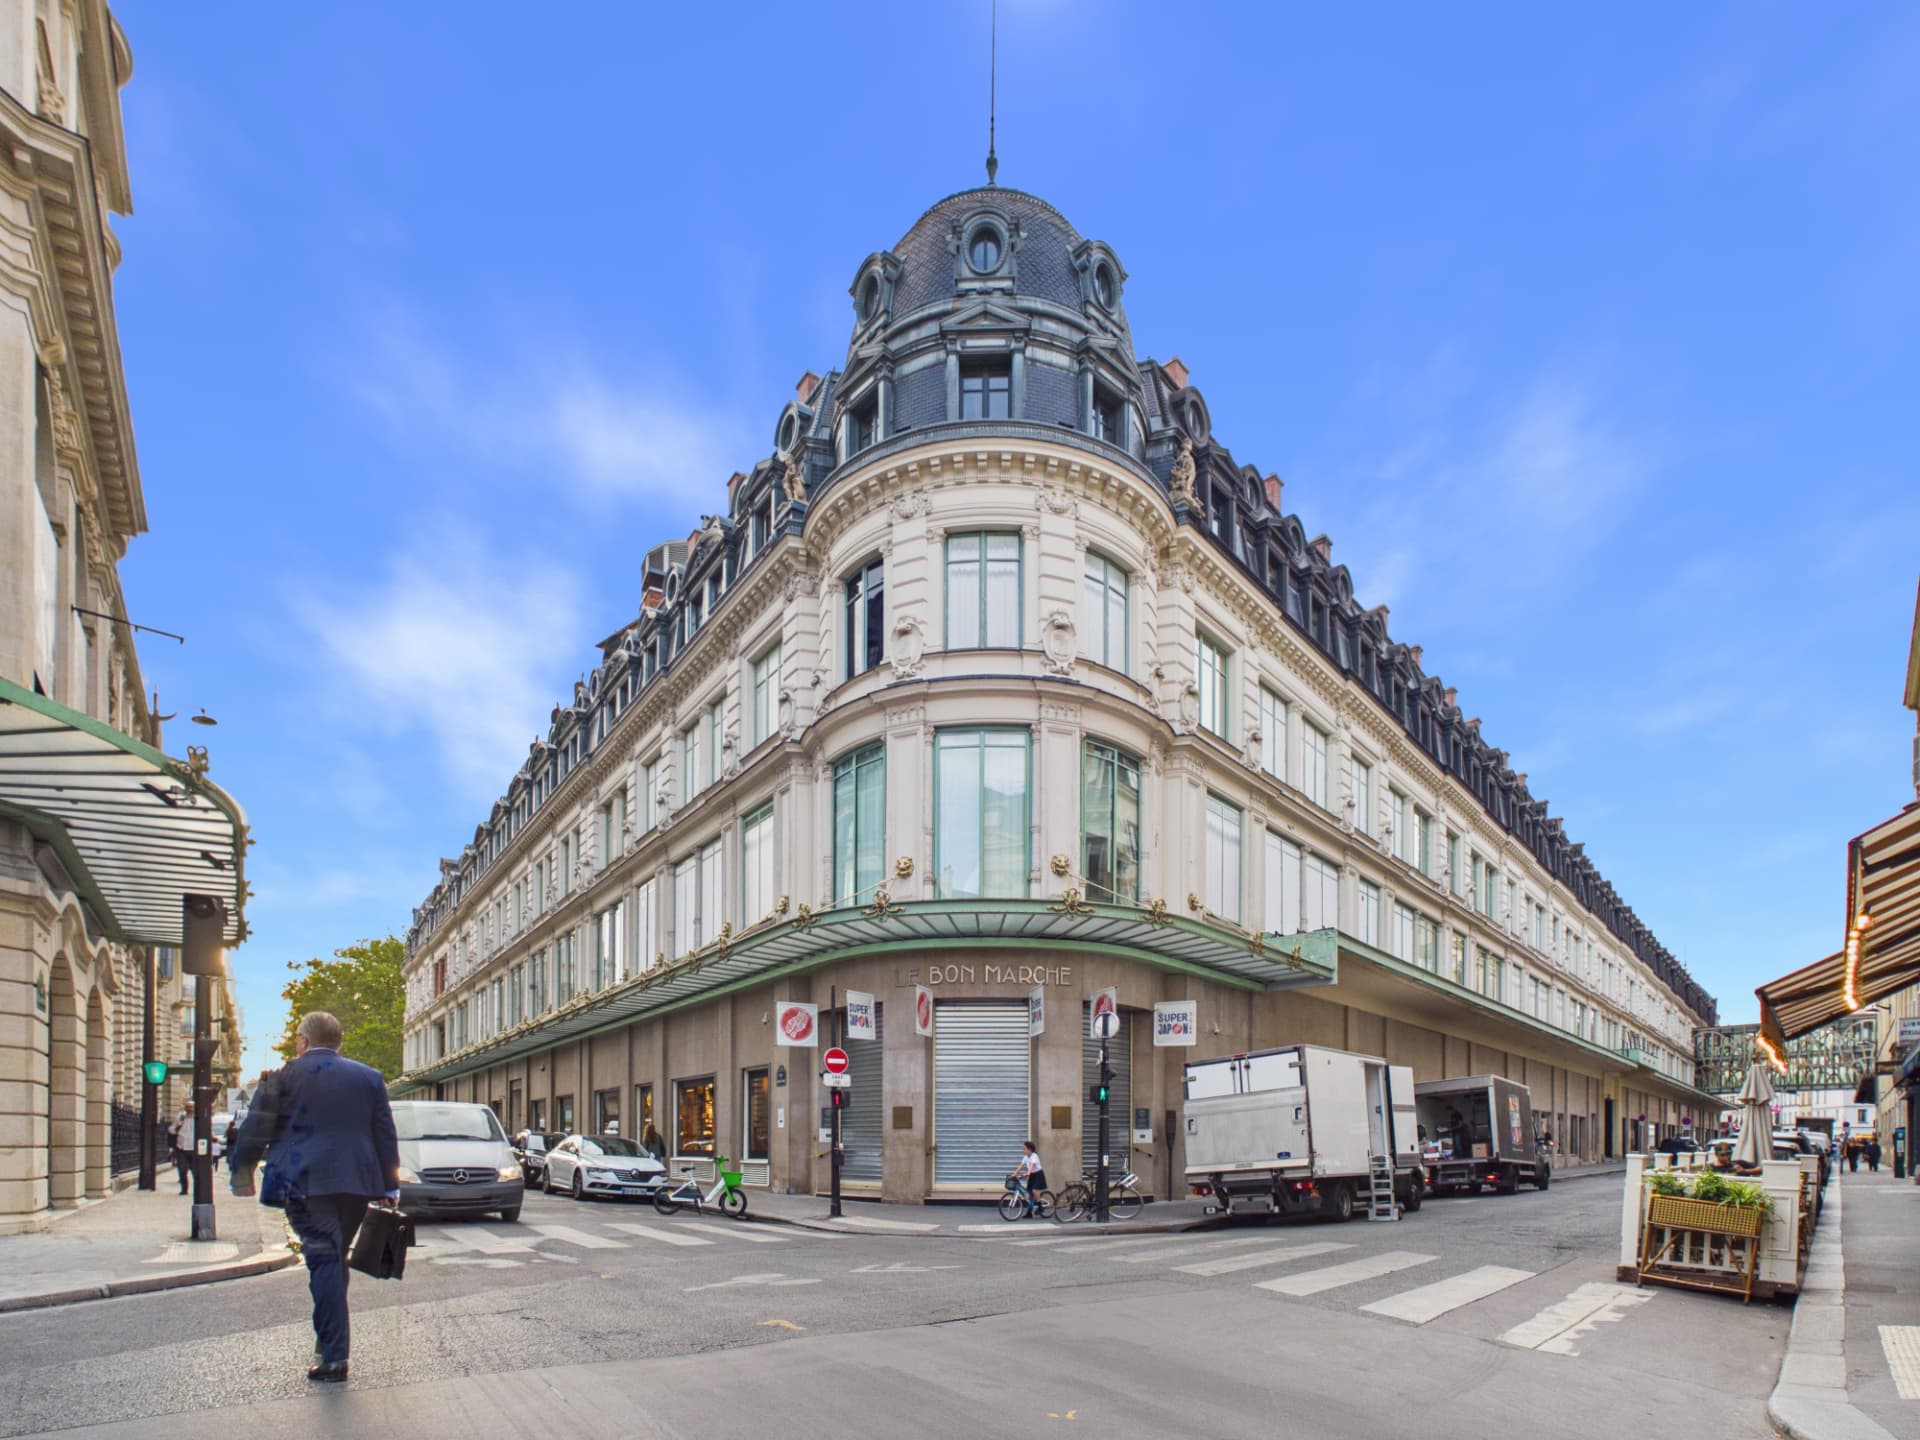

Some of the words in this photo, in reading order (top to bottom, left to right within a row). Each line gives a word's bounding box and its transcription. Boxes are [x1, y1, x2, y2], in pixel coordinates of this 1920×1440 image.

[896, 968, 920, 987] LE
[929, 965, 975, 985] BON
[985, 965, 1073, 985] MARCHE
[1158, 1012, 1188, 1022] SUPER
